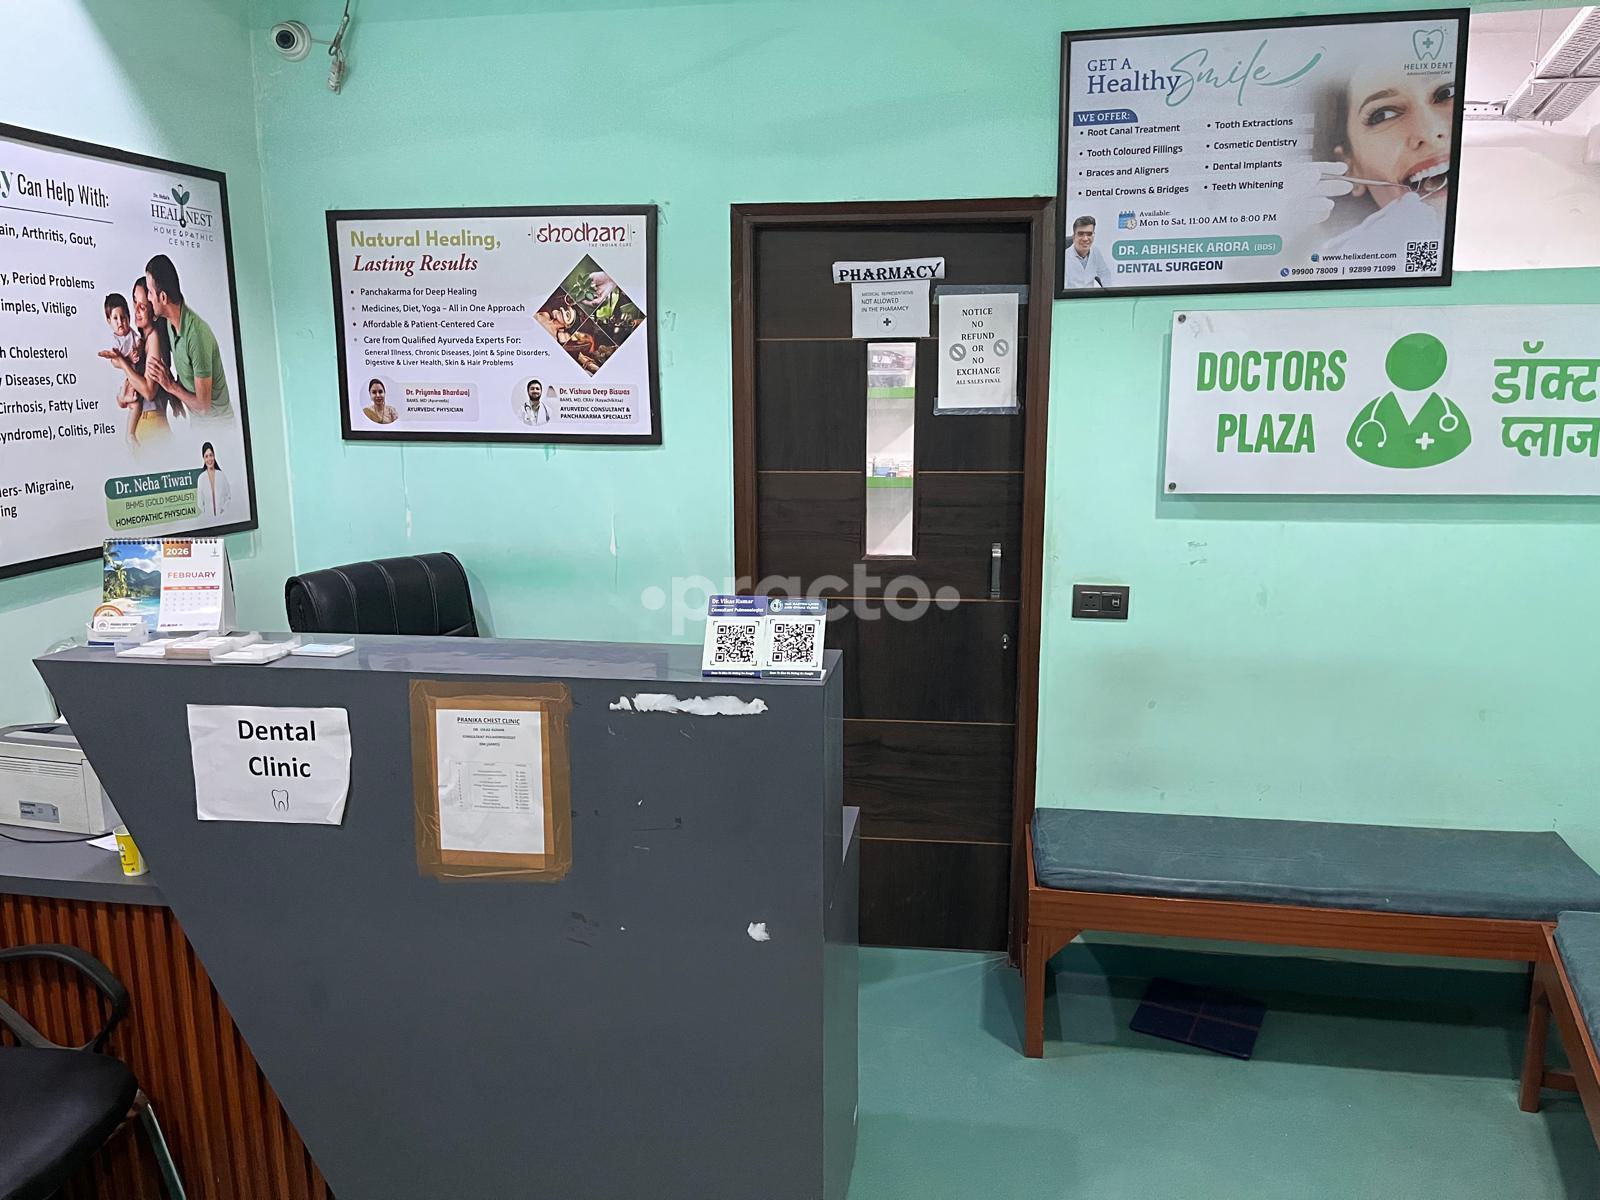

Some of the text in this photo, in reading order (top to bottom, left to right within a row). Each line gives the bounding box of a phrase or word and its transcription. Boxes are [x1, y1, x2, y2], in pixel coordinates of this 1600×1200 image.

[1087, 58, 1132, 71] GET A
[1087, 39, 1271, 107] Healthy Smile
[1078, 112, 1130, 122] WE OFFER:
[1215, 118, 1293, 129] Tooth Extractions
[1087, 124, 1180, 136] Root Canal Treatment
[1087, 144, 1183, 157] Tooth Coloured Fillings
[1213, 138, 1297, 150] Cosmetic Dentistry
[1086, 166, 1169, 177] Braces and Aligners
[1212, 160, 1282, 170] Dental Implants
[18, 174, 41, 197] Can
[46, 179, 74, 206] Help
[78, 184, 109, 208] With:
[1085, 185, 1189, 197] Dental Crowns & Bridges
[1212, 180, 1284, 192] Teeth Whitening
[1139, 219, 1158, 227] Mon
[22, 226, 67, 244] Arthritis,
[70, 232, 96, 248] Gout,
[169, 238, 201, 248] CENTER
[351, 229, 501, 250] Natural Healing,
[1118, 245, 1138, 255] DR.
[1141, 243, 1204, 255] ABHISHEK
[1206, 241, 1249, 253] ARORA
[1322, 252, 1397, 261] www.helixdent.com
[353, 253, 478, 277] Lasting Results
[839, 262, 941, 281] PHARMACY
[1117, 260, 1223, 273] DENTAL SURGEON
[13, 272, 45, 285] Period
[49, 275, 95, 289] Problems
[360, 288, 477, 297] Panchakarma for Deep Healing
[42, 302, 77, 317] Vitiligo
[361, 305, 402, 313] Medicines,
[403, 305, 421, 313] Diet,
[423, 305, 441, 314] Yoga
[487, 304, 525, 314] Approach
[962, 308, 993, 316] NOTICE
[972, 320, 984, 328] NO
[364, 336, 521, 345] Care from Qualified Ayurveda Experts For:
[961, 332, 995, 340] REFUND
[10, 346, 68, 359] Cholesterol
[972, 356, 984, 364] NO
[956, 367, 1000, 376] EXCHANGE
[1197, 349, 1348, 392] DOCTORS
[6, 374, 53, 387] Diseases,
[56, 373, 77, 385] CKD
[49, 400, 73, 413] Fatty
[76, 399, 98, 411] Liver
[58, 423, 115, 437] Colitis, Piles
[1217, 413, 1316, 453] PLAZA
[25, 479, 74, 496] Migraine,
[115, 473, 192, 494] Dr. Neha Tiwari
[116, 507, 196, 527] HOMEOPATHIC PHYSICIAN
[166, 548, 189, 556] 2026
[238, 720, 316, 741] Dental
[249, 756, 311, 777] Clinic
